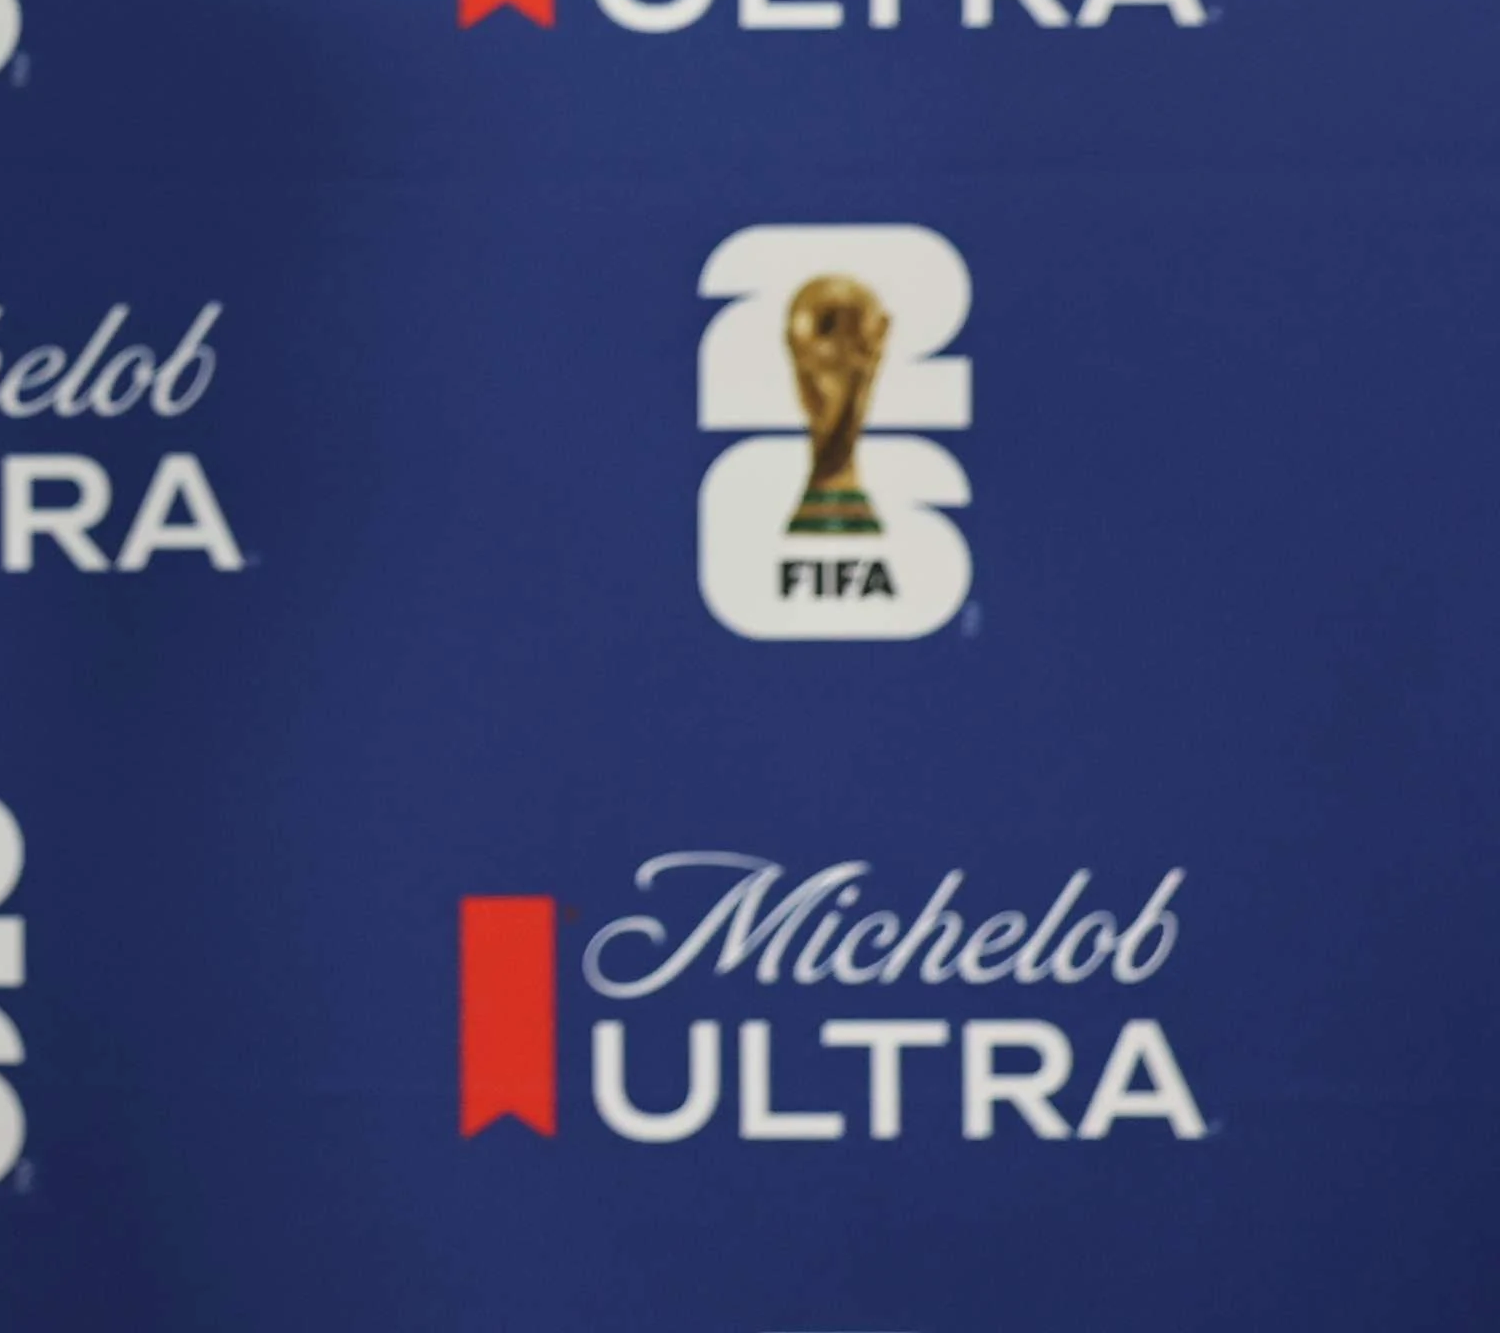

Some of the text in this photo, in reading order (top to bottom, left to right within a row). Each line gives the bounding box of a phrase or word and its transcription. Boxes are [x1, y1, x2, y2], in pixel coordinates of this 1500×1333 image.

[780, 561, 895, 597] FIFA
[583, 852, 1184, 998] Michelob
[592, 1019, 1208, 1143] ULTRA
